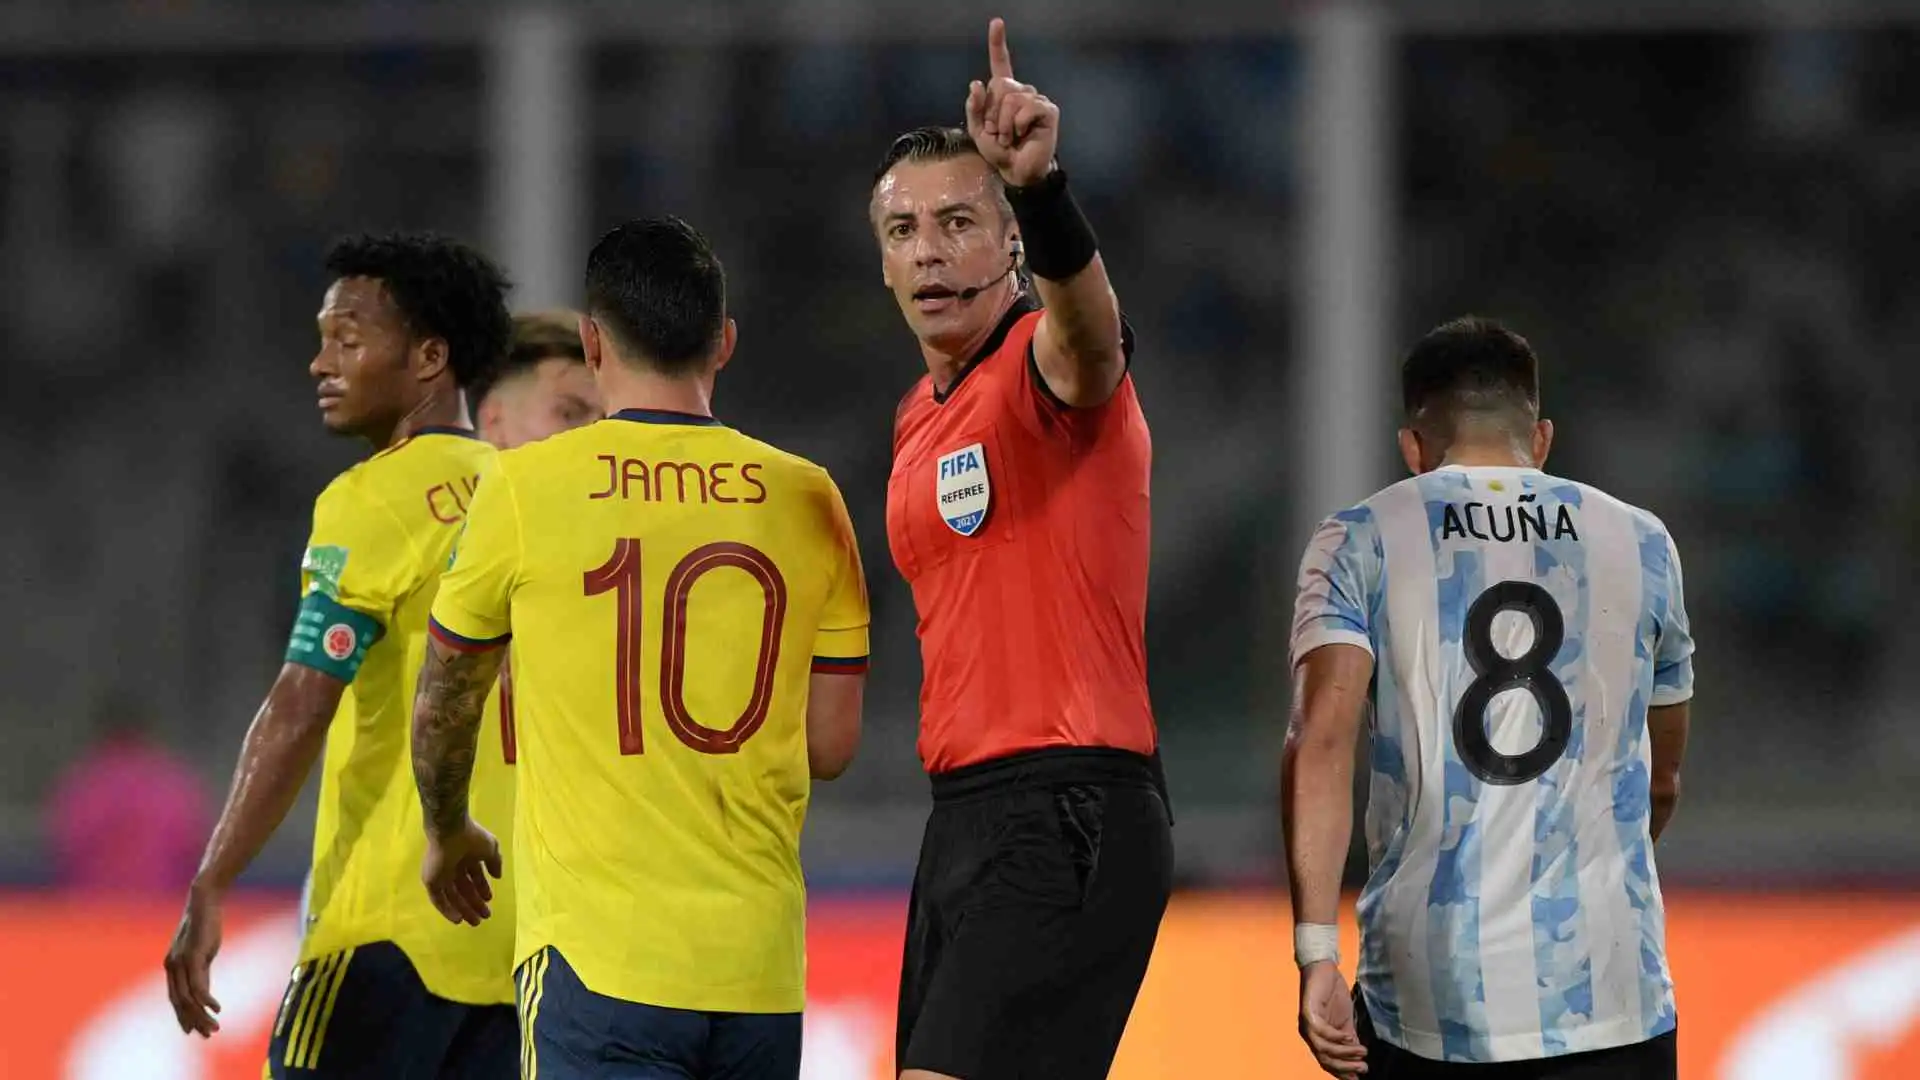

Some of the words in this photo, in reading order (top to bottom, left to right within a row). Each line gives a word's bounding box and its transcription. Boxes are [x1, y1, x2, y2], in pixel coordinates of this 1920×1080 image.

[589, 455, 767, 504] JAMES
[941, 451, 980, 481] FIFA
[427, 474, 480, 524] CU
[941, 484, 985, 504] REFEREE
[1442, 494, 1579, 542] ACUÑA
[955, 515, 977, 529] 2021
[584, 537, 787, 755] 10
[1453, 580, 1572, 786] 8
